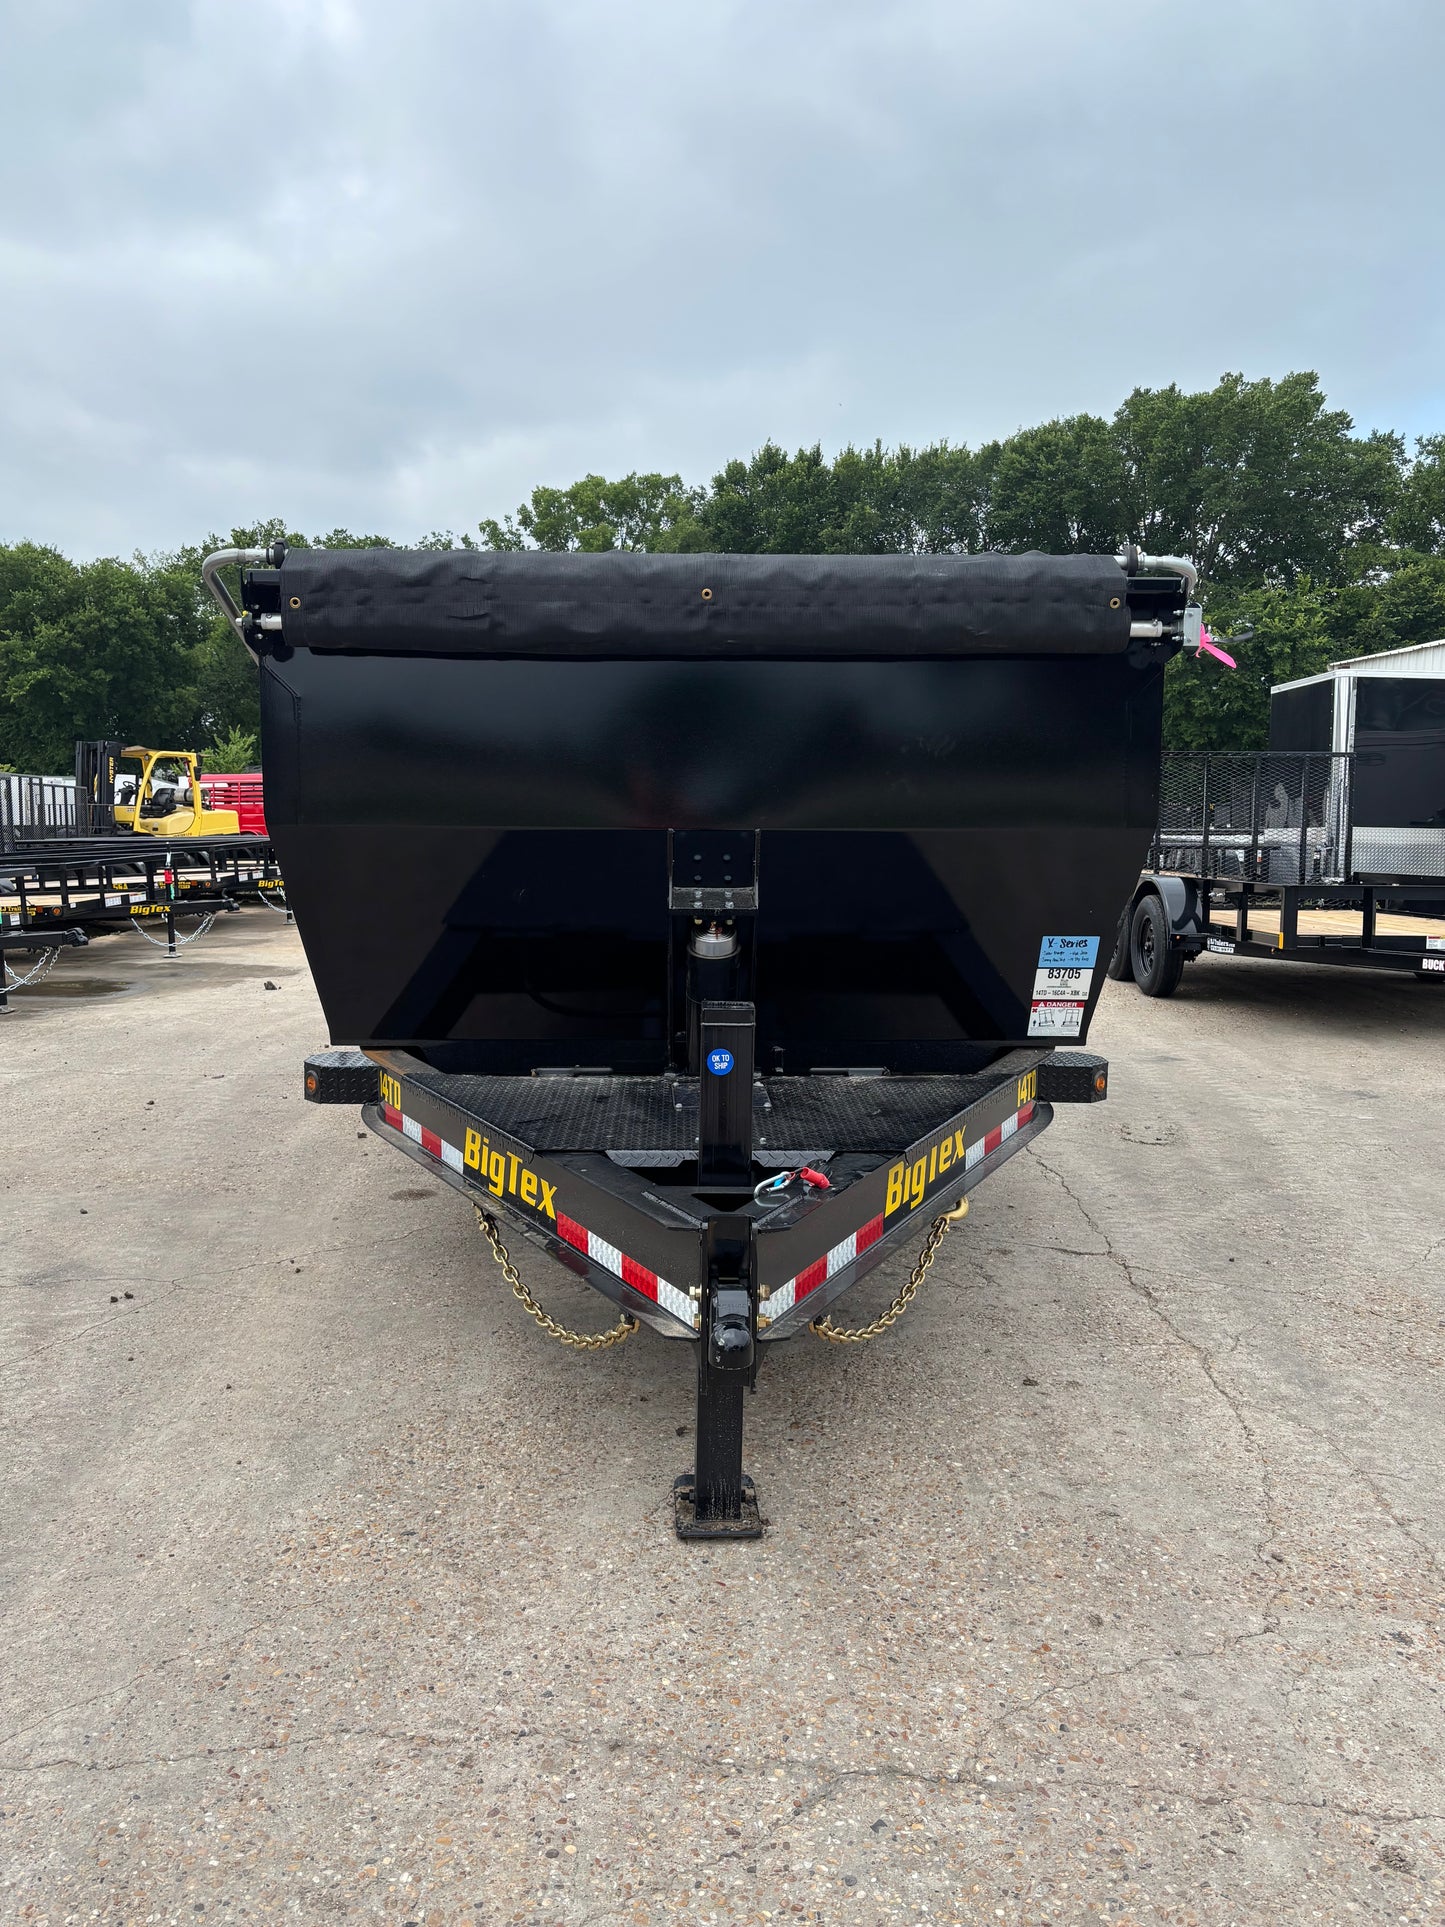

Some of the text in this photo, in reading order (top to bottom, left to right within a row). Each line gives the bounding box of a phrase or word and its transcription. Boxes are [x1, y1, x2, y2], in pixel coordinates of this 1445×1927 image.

[258, 880, 284, 888] BigTe
[130, 904, 170, 915] BigTex
[1048, 969, 1080, 980] 83705
[380, 1070, 400, 1110] 14TD
[1017, 1069, 1036, 1108] 14TD
[464, 1127, 557, 1220] BigTex
[885, 1124, 966, 1218] BigTex
